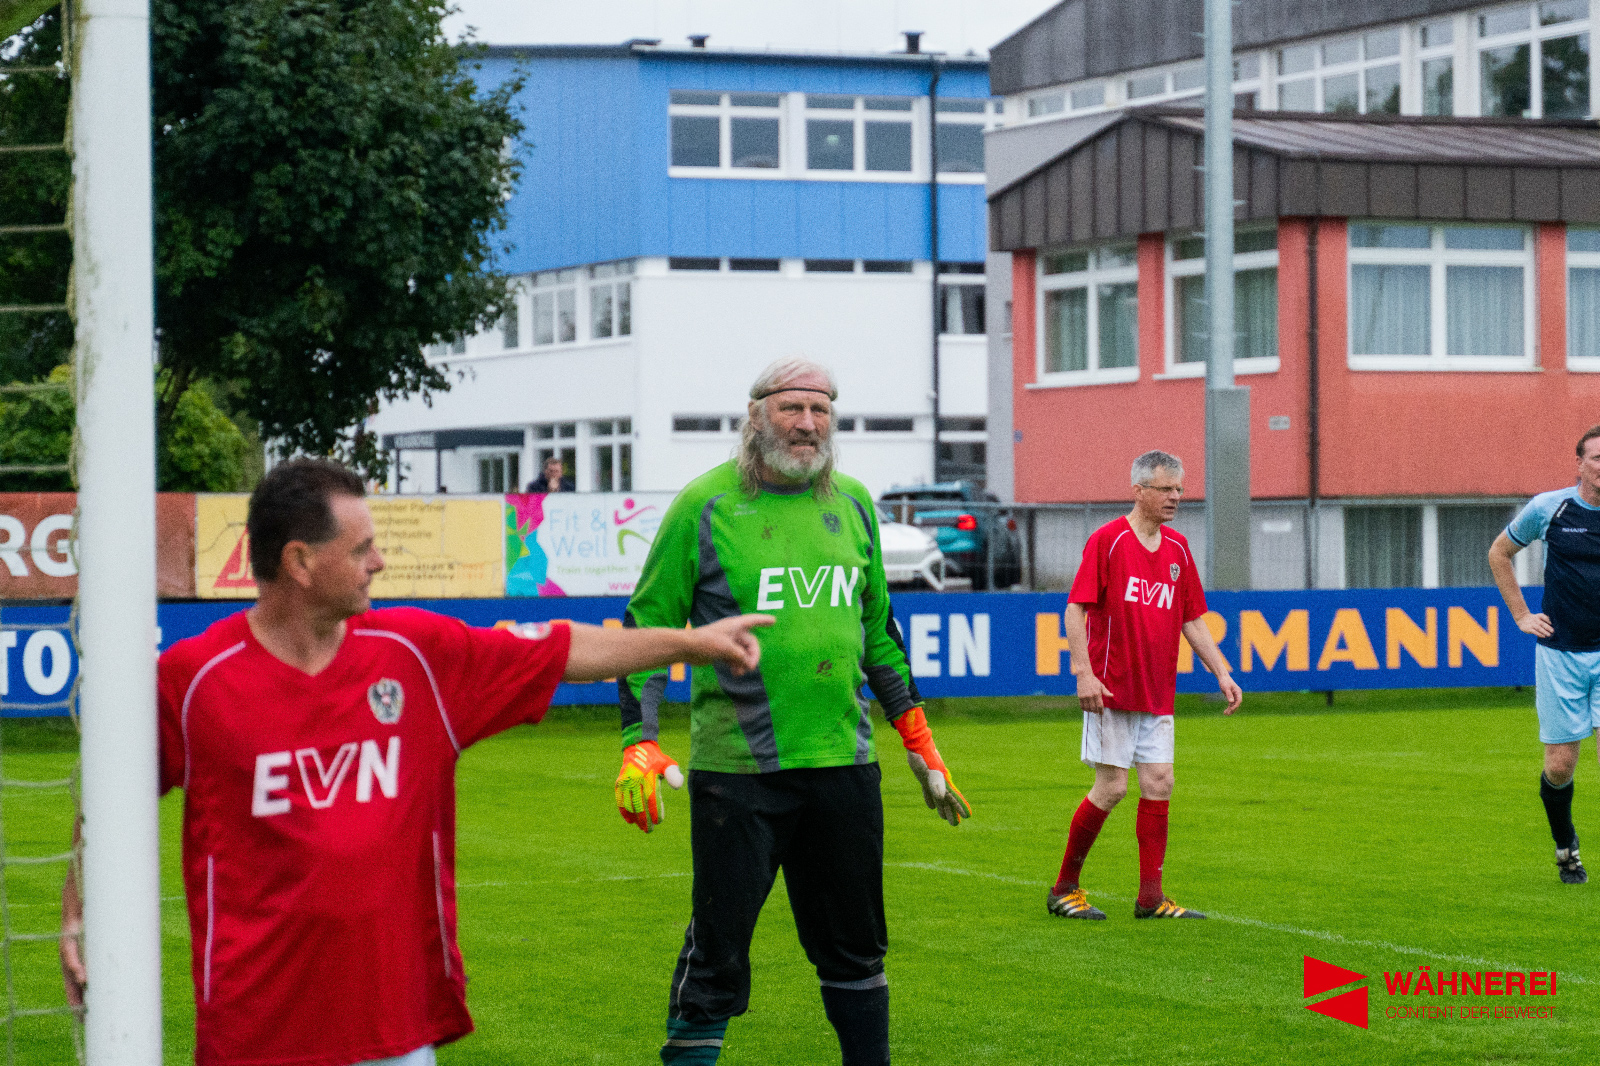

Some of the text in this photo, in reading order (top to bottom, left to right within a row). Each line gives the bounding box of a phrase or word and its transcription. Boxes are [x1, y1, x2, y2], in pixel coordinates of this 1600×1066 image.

[550, 508, 607, 532] Fit &
[551, 535, 608, 558] Well
[757, 565, 859, 611] EVN
[1124, 576, 1175, 610] EVN
[892, 613, 991, 678] EN
[1035, 605, 1499, 677] HRMANN
[251, 736, 400, 818] EVN
